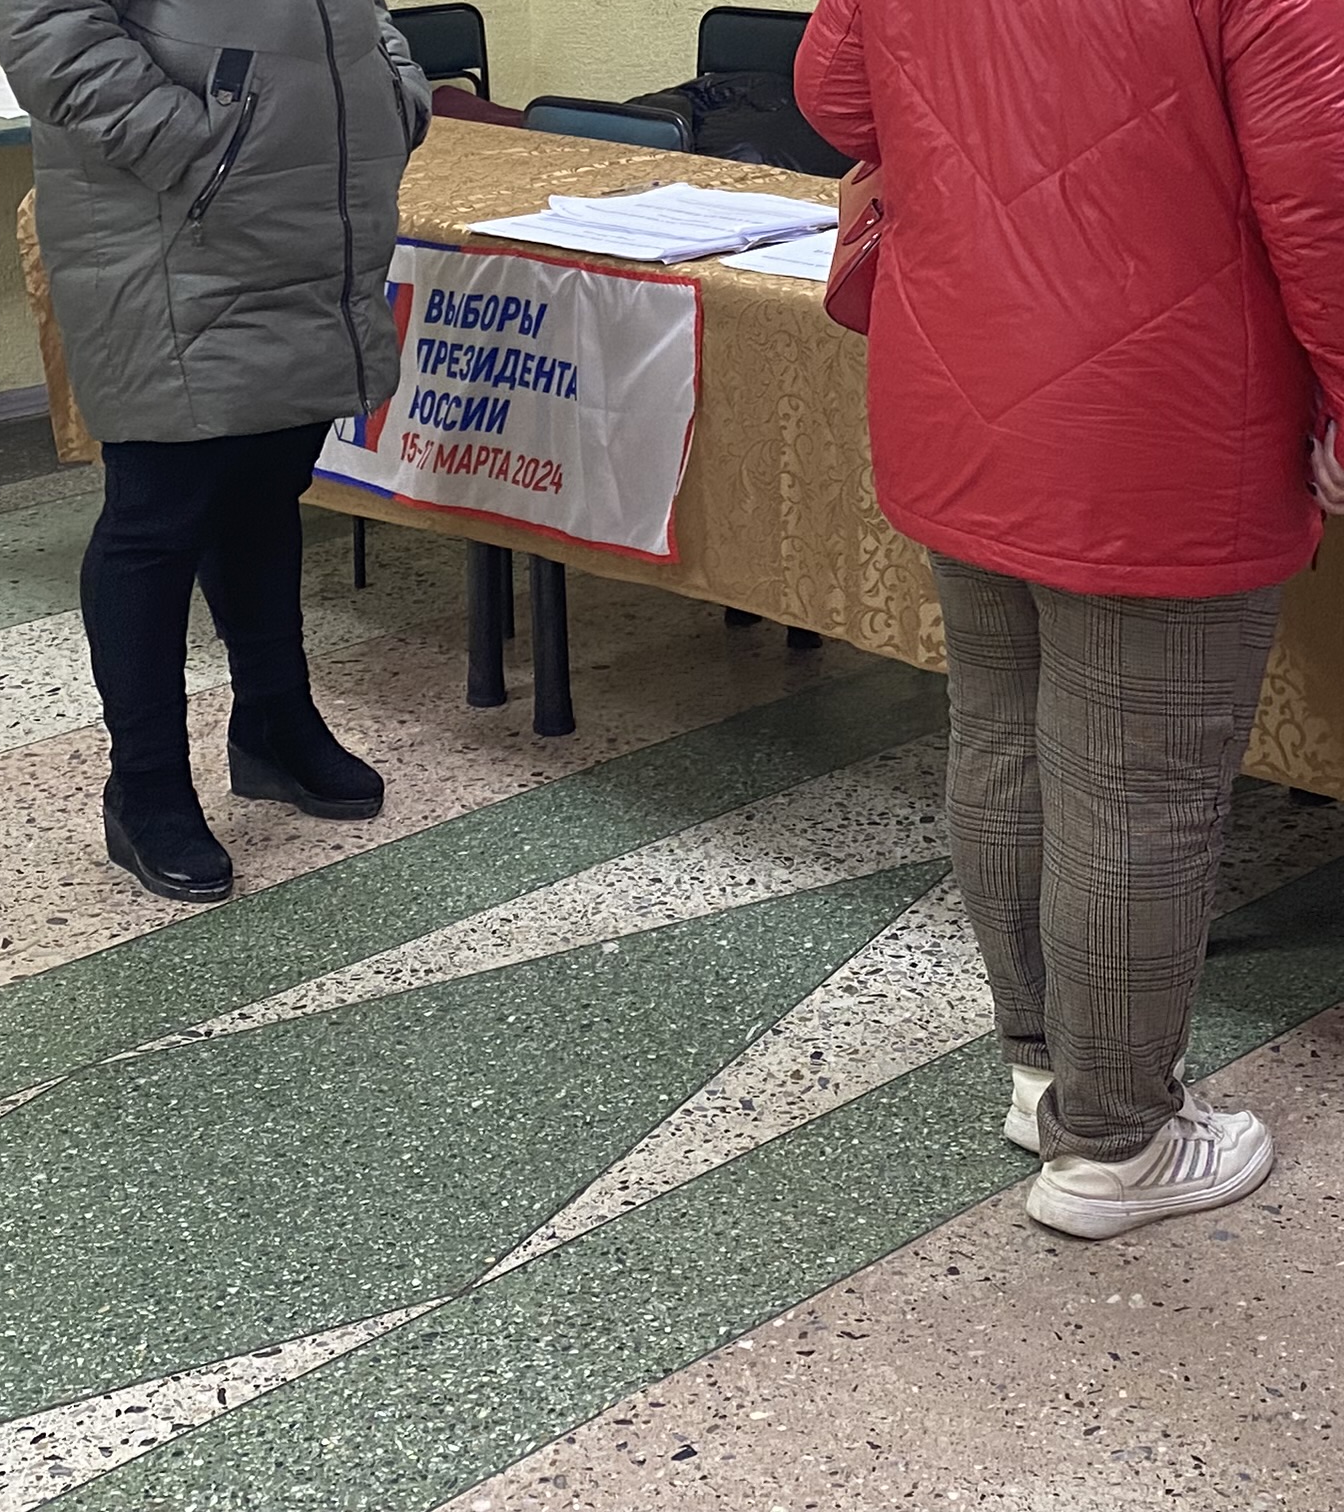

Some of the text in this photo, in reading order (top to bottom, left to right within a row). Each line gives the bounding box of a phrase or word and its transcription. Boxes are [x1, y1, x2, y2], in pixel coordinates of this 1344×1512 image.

[423, 288, 548, 340] ВЫБОРЫ
[416, 337, 578, 402] ПРЕЗИДЕНТА
[432, 442, 512, 482] МАРТА
[511, 454, 564, 495] 2024
